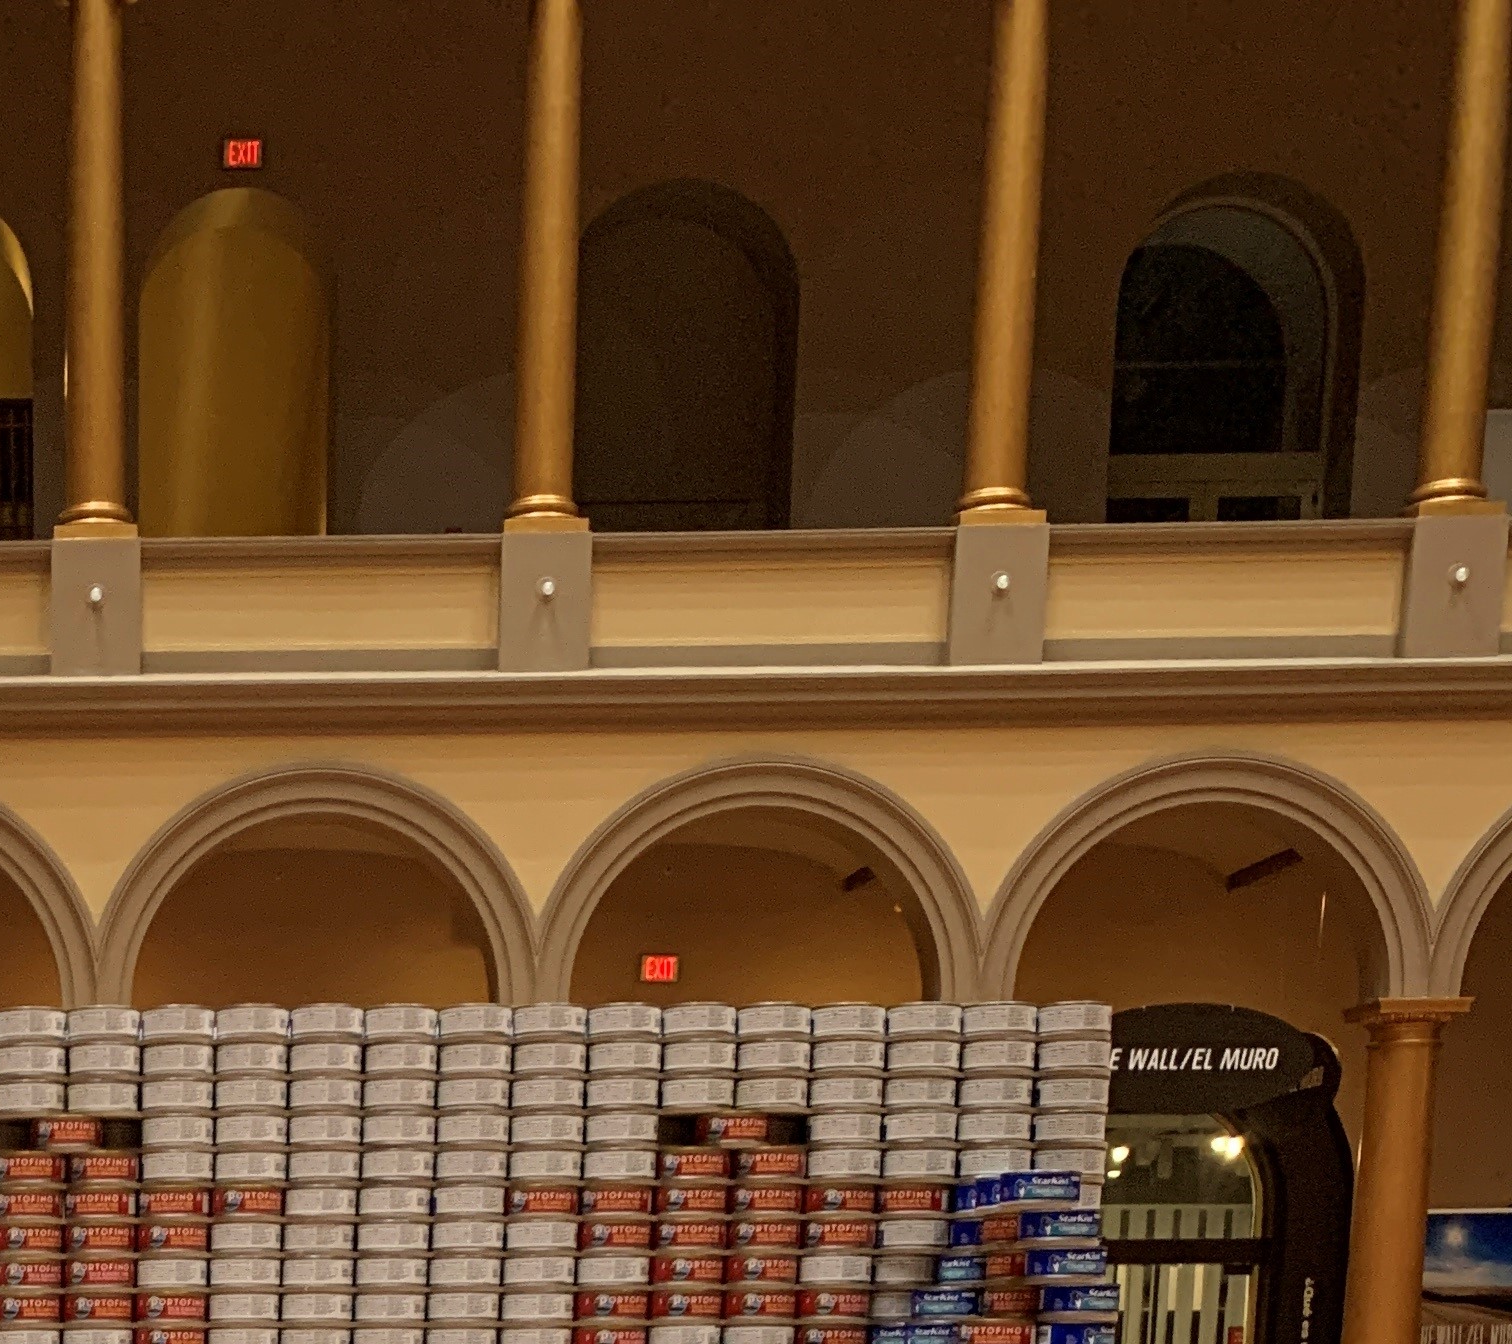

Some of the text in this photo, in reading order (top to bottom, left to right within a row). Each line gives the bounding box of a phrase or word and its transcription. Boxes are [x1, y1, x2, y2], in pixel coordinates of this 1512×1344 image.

[228, 140, 260, 166] EXIT
[645, 956, 677, 982] EXIT
[1128, 1047, 1213, 1071] WALL/EL
[1219, 1047, 1279, 1071] MURO
